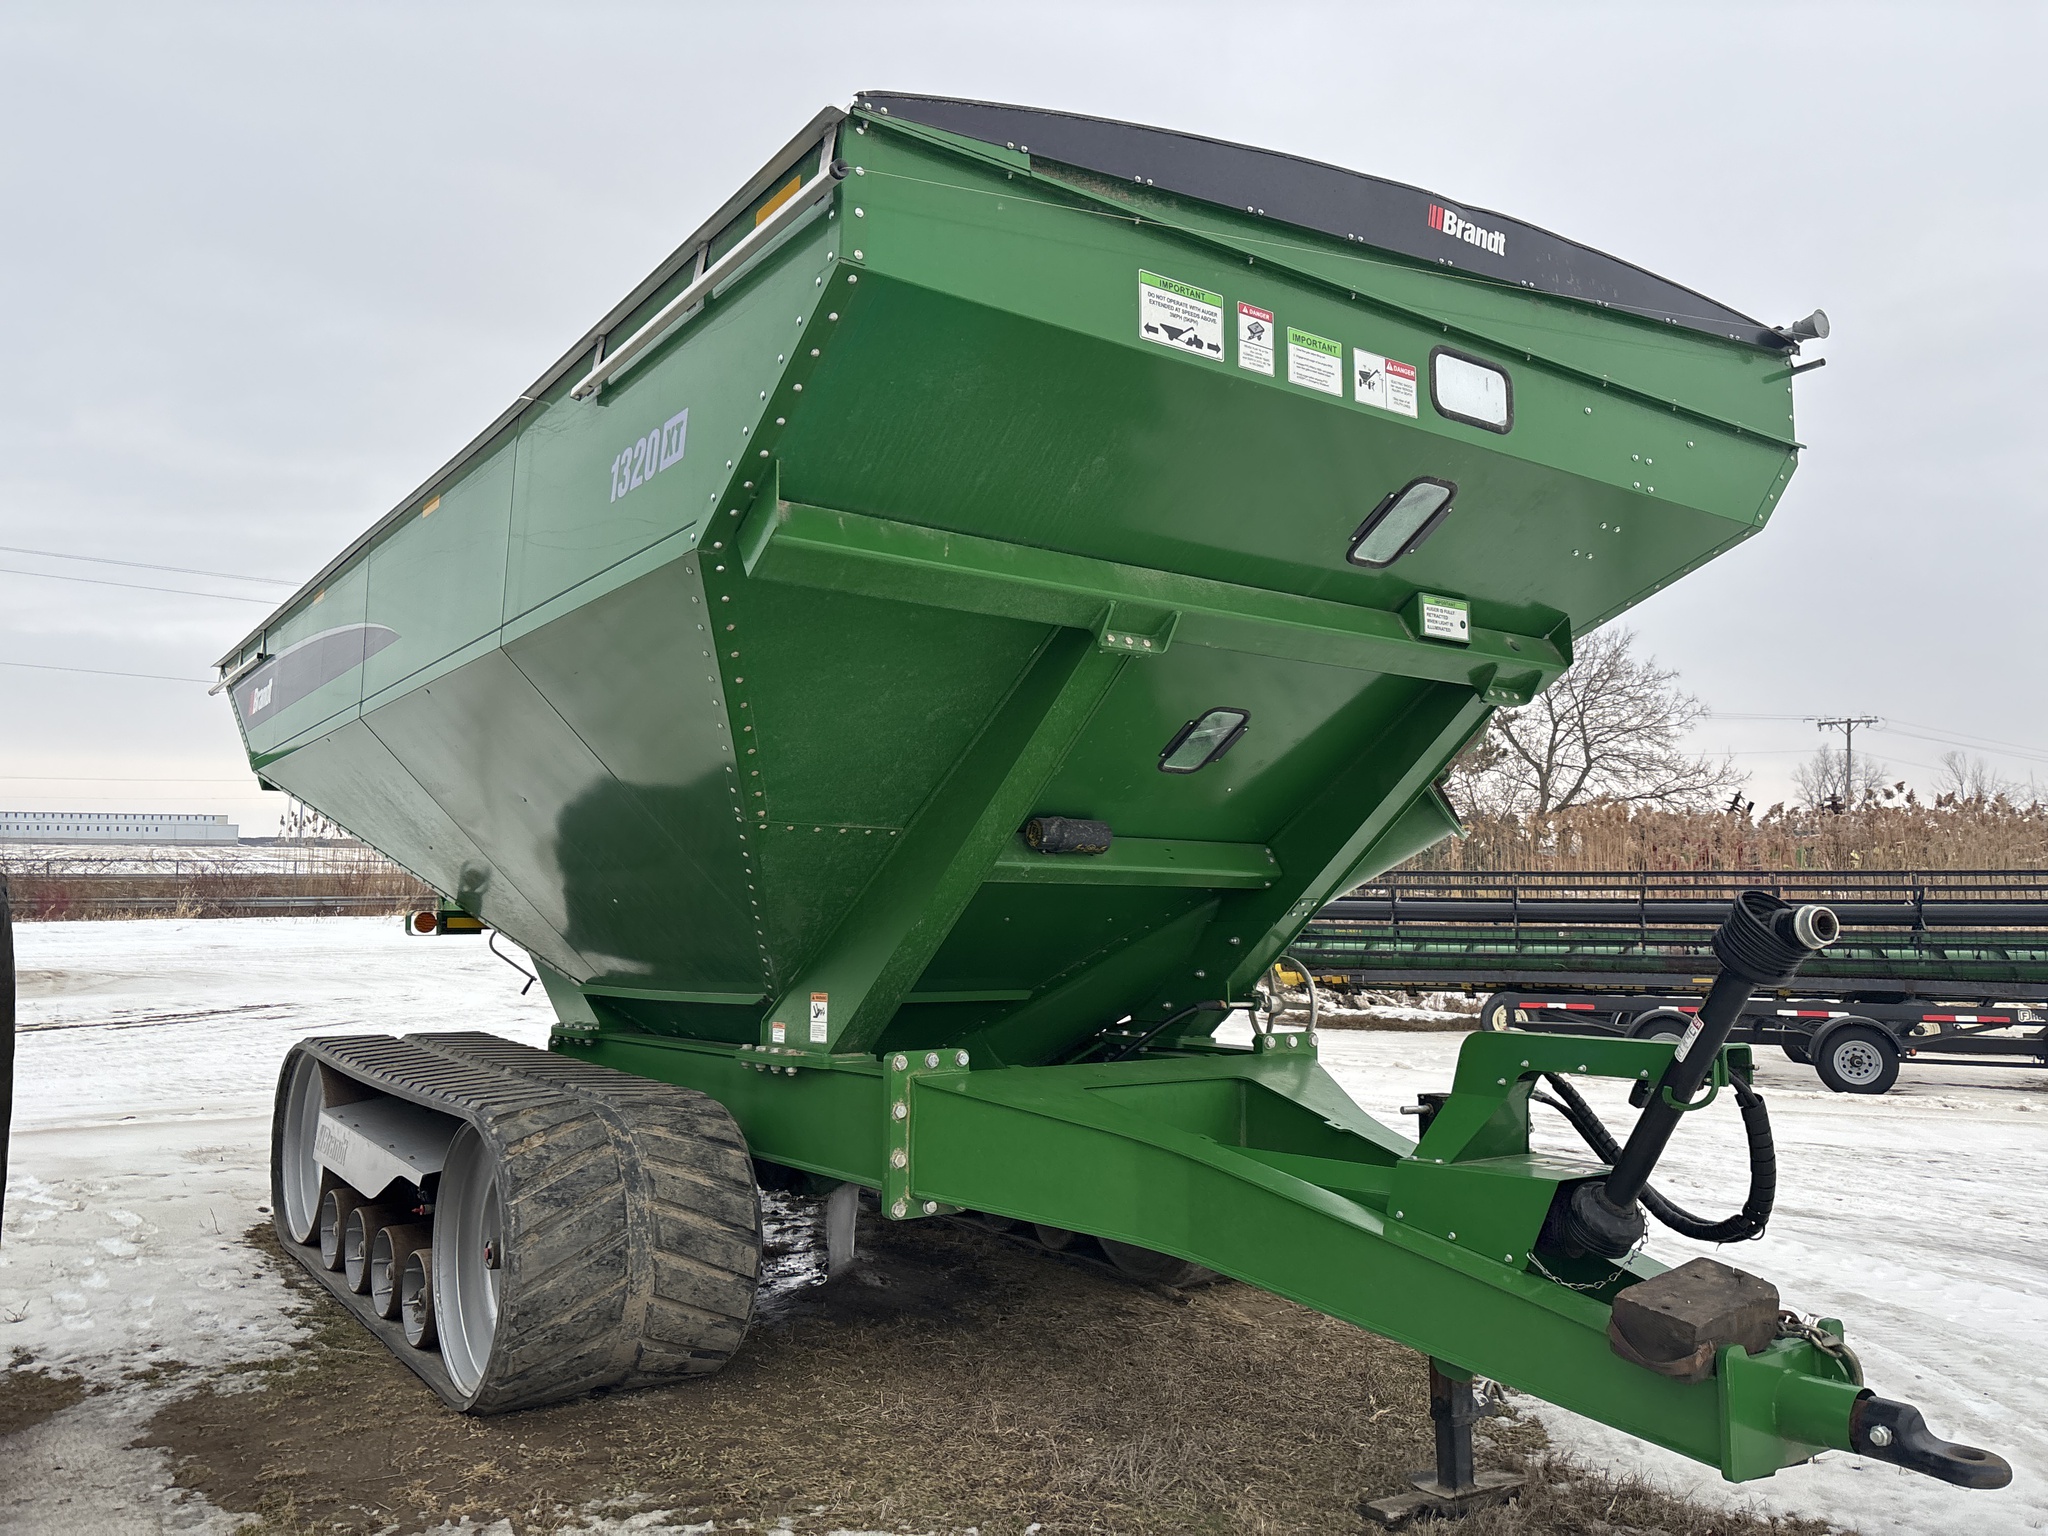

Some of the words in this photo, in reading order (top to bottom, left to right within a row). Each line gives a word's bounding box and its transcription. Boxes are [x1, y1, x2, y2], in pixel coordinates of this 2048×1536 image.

[1442, 208, 1506, 257] Brandt
[1159, 279, 1206, 301] IMPORTANT
[1147, 291, 1156, 299] DO
[1155, 293, 1166, 301] NOT
[1166, 297, 1189, 309] OPERATE
[1189, 304, 1201, 312] WITH
[1201, 308, 1218, 317] AUGER
[1148, 298, 1175, 311] EXTENDED
[1181, 308, 1200, 319] SPEEDS
[1249, 309, 1270, 320] DANGER
[1292, 333, 1337, 354] IMPORTANT
[1393, 365, 1415, 377] DANGER
